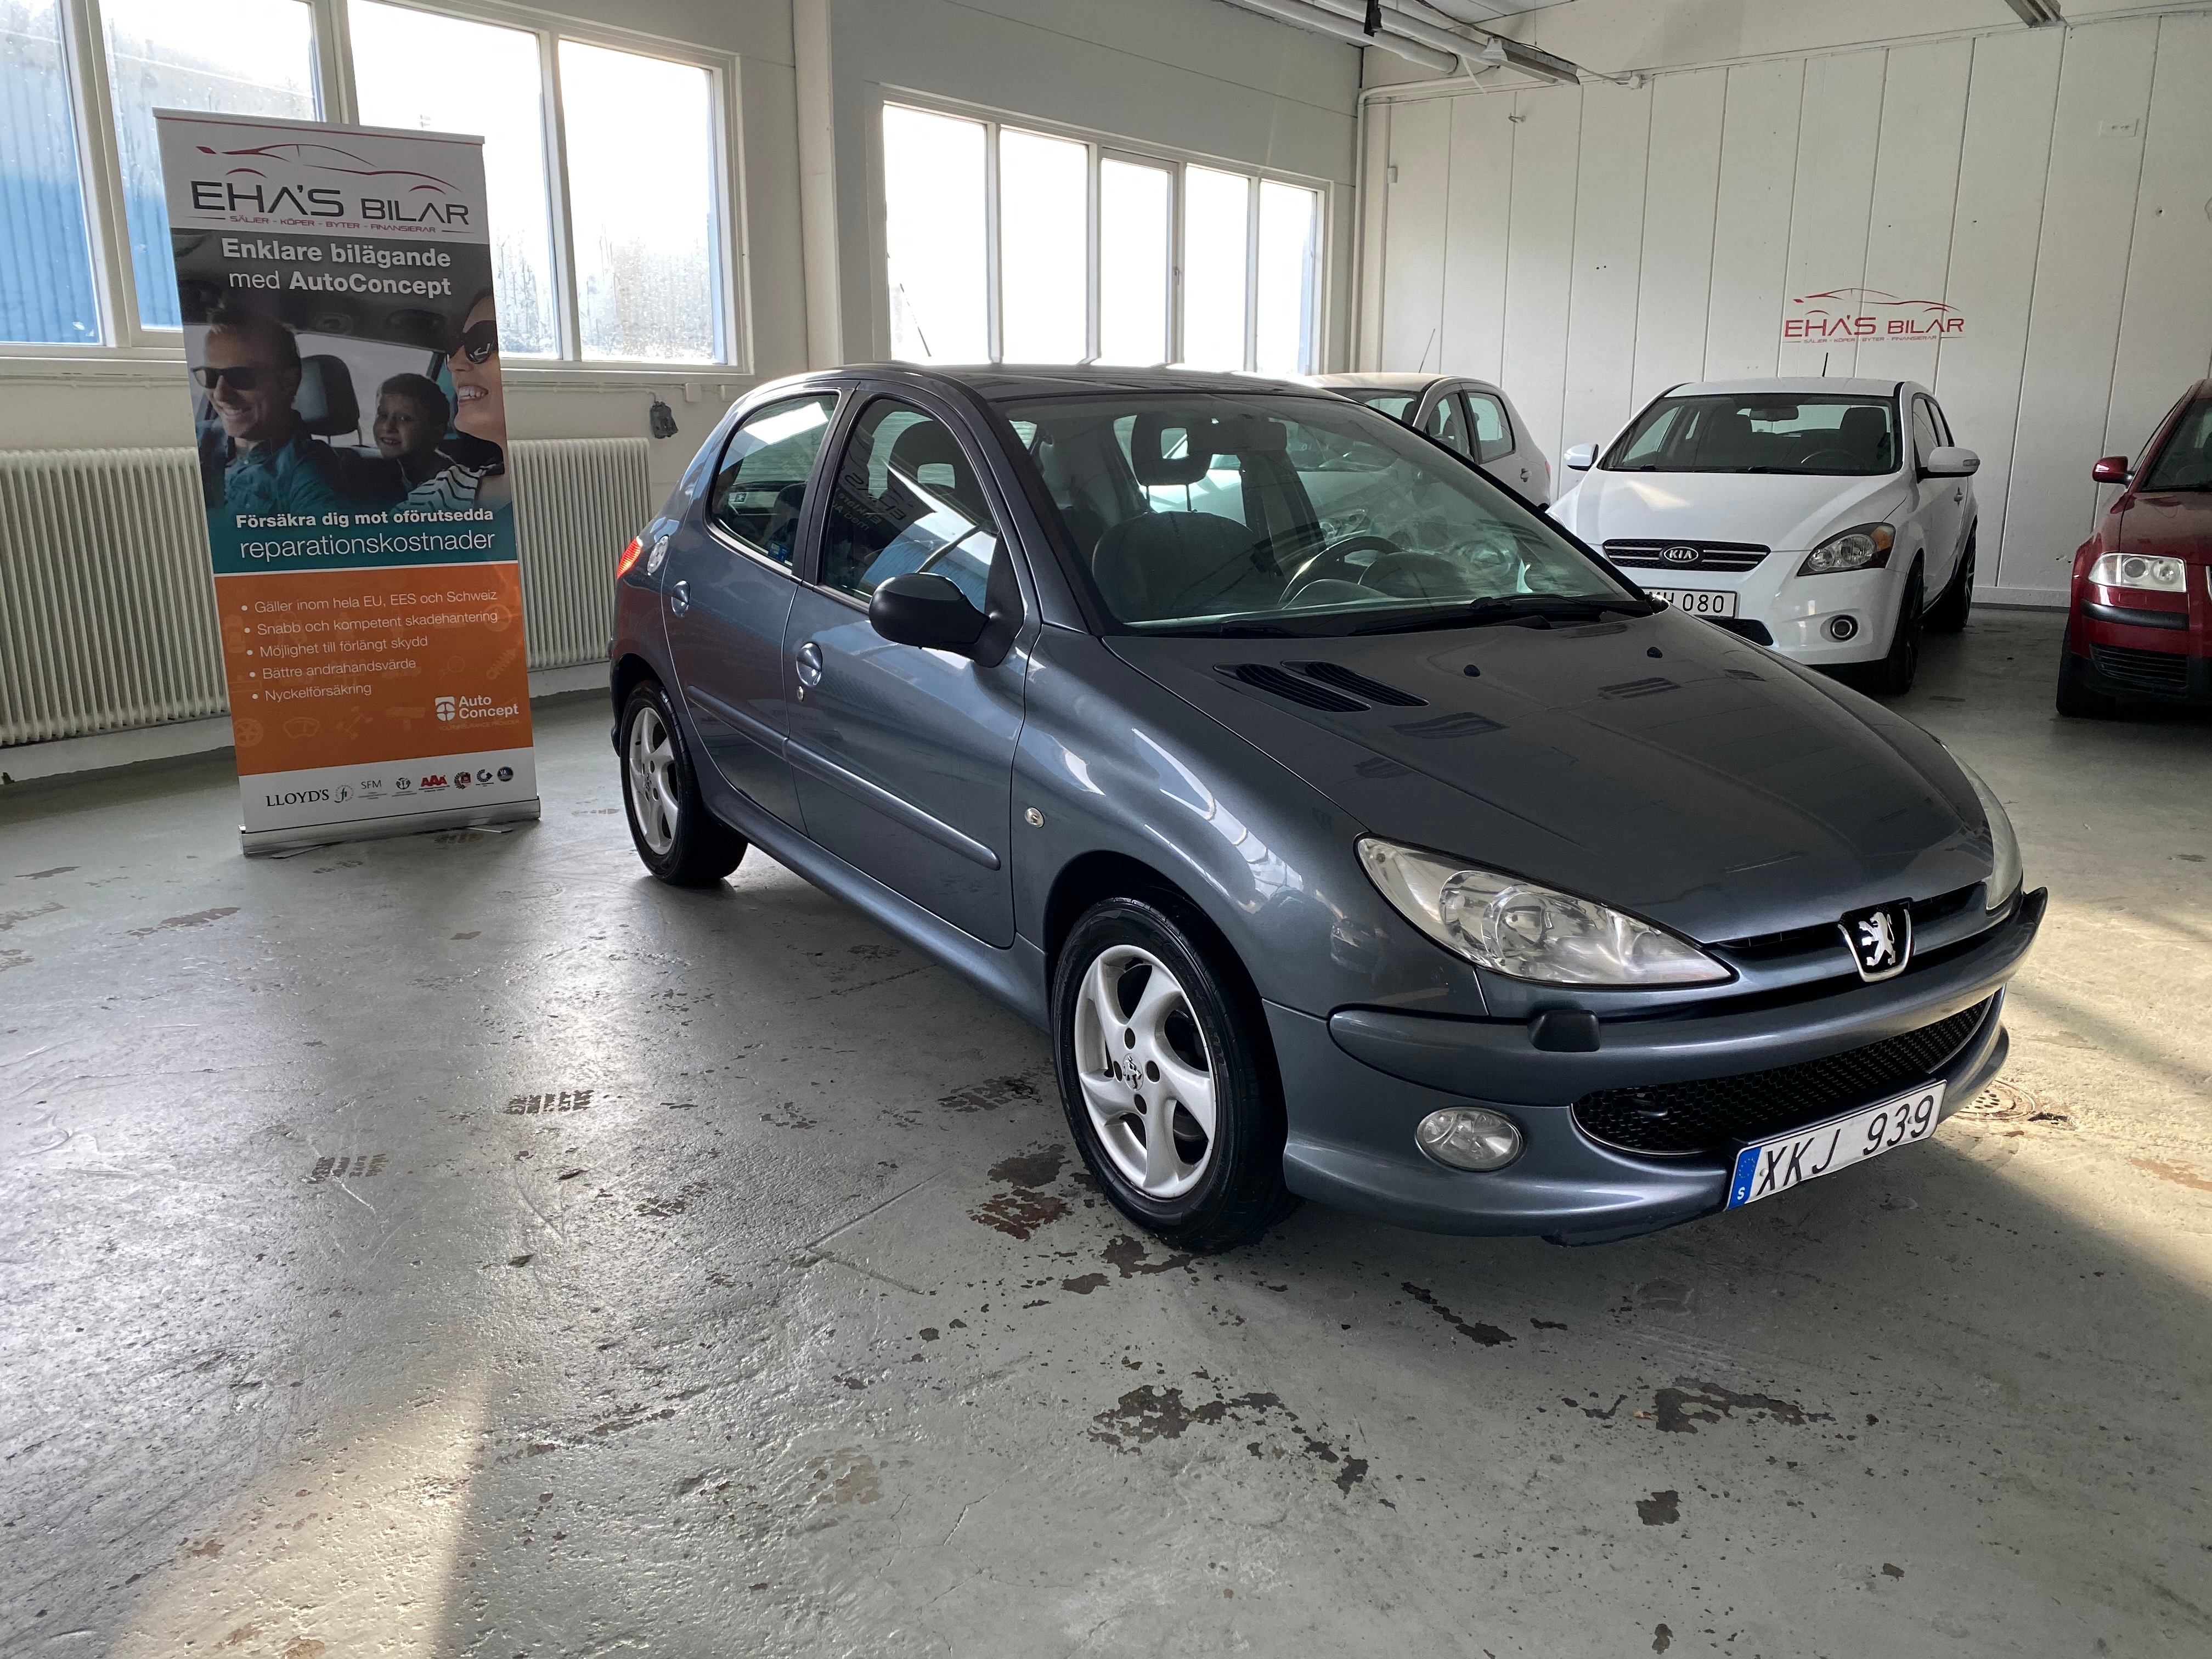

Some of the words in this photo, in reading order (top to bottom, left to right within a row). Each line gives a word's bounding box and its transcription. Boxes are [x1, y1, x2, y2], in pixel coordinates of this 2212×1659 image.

[190, 180, 344, 218] EHA'S
[360, 198, 469, 225] BILAR
[280, 218, 314, 227] KÖPER
[370, 223, 436, 233] FINANSIERAR
[222, 238, 323, 262] Enklare
[330, 242, 452, 269] bilägande
[228, 270, 280, 290] med
[289, 272, 452, 298] AutoConcept
[1785, 315, 1876, 337] EHA'S
[1887, 318, 1965, 334] BILAR
[235, 513, 316, 528] Försäkra
[322, 512, 349, 528] dig
[354, 511, 388, 525] mot
[393, 508, 493, 524] oförutsedda
[240, 529, 495, 562] reparationskostnader
[1669, 549, 1691, 560] KIA
[254, 601, 292, 613] Gäller
[297, 599, 329, 611] inom
[333, 597, 360, 609] hela
[364, 596, 386, 608] EU,
[390, 594, 416, 606] EES
[420, 592, 443, 604] och
[447, 589, 497, 603] Schweiz
[1683, 593, 1724, 613] 080
[257, 622, 301, 636] Snabb
[305, 620, 329, 633] och
[334, 616, 402, 633] kompetent
[405, 610, 498, 627] skadehantering
[259, 644, 319, 660] Möjlighet
[323, 642, 336, 653] till
[339, 639, 387, 654] förlängt
[391, 636, 428, 651] skydd
[262, 666, 302, 680] Bättre
[307, 658, 416, 676] andrahandsvärde
[265, 683, 372, 702] Nyckelförsäkring
[459, 695, 492, 707] Auto
[459, 703, 520, 719] Concept
[361, 780, 382, 789] SFM
[266, 789, 329, 806] LLOYD'S
[1757, 1128, 1841, 1195] XKJ
[1863, 1094, 1934, 1156] 939
[1736, 1186, 1746, 1200] S
